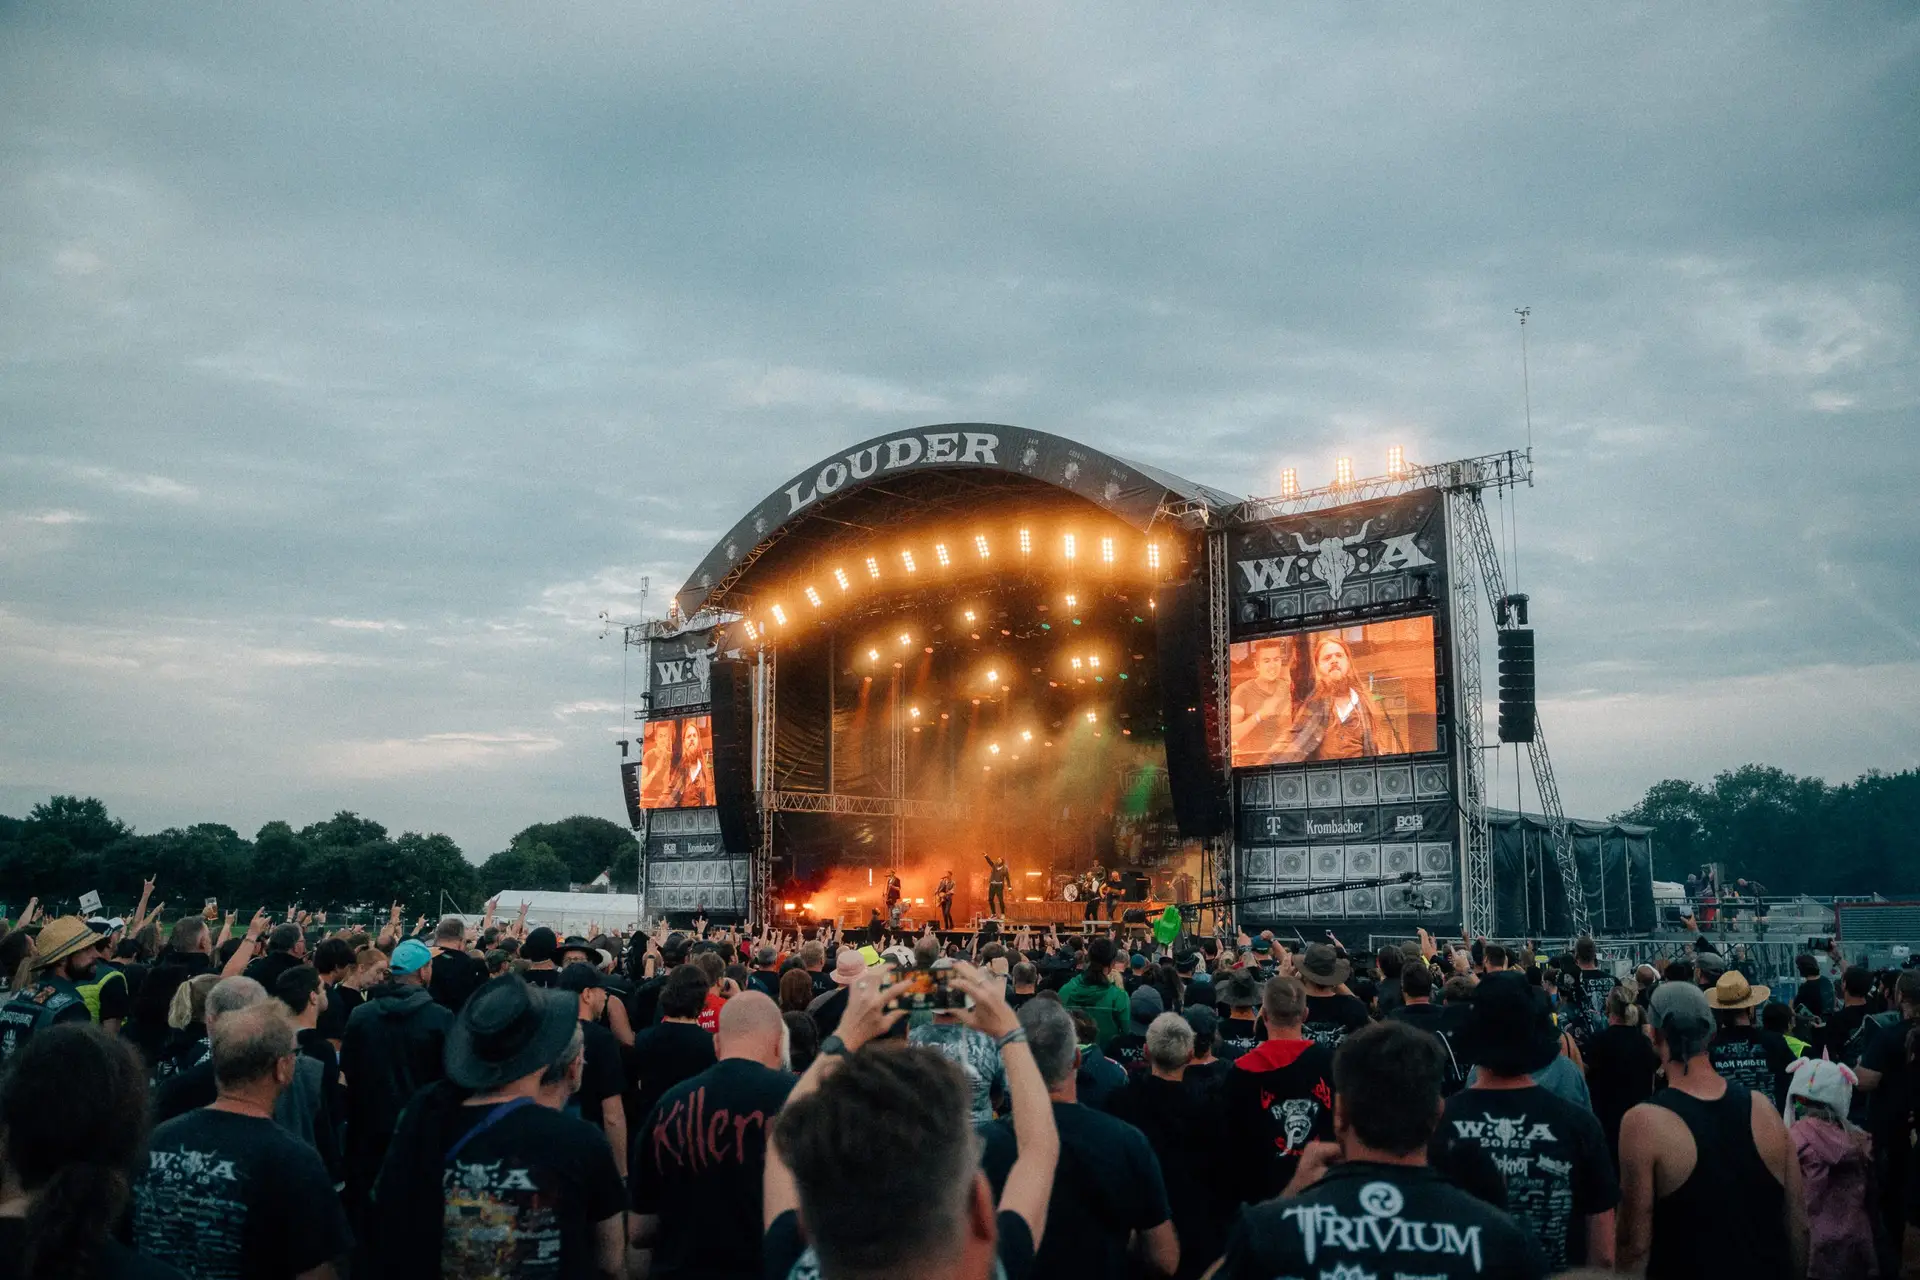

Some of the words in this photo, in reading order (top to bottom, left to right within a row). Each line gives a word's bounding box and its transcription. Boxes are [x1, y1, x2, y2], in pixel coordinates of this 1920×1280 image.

[785, 432, 1000, 516] LOUDER
[1306, 818, 1364, 835] Krombacher
[702, 1009, 714, 1017] wir
[702, 1020, 715, 1028] mit
[1715, 1060, 1735, 1069] IRON
[1736, 1059, 1767, 1068] MAIDEN
[1280, 1203, 1484, 1274] TRIVIUM
